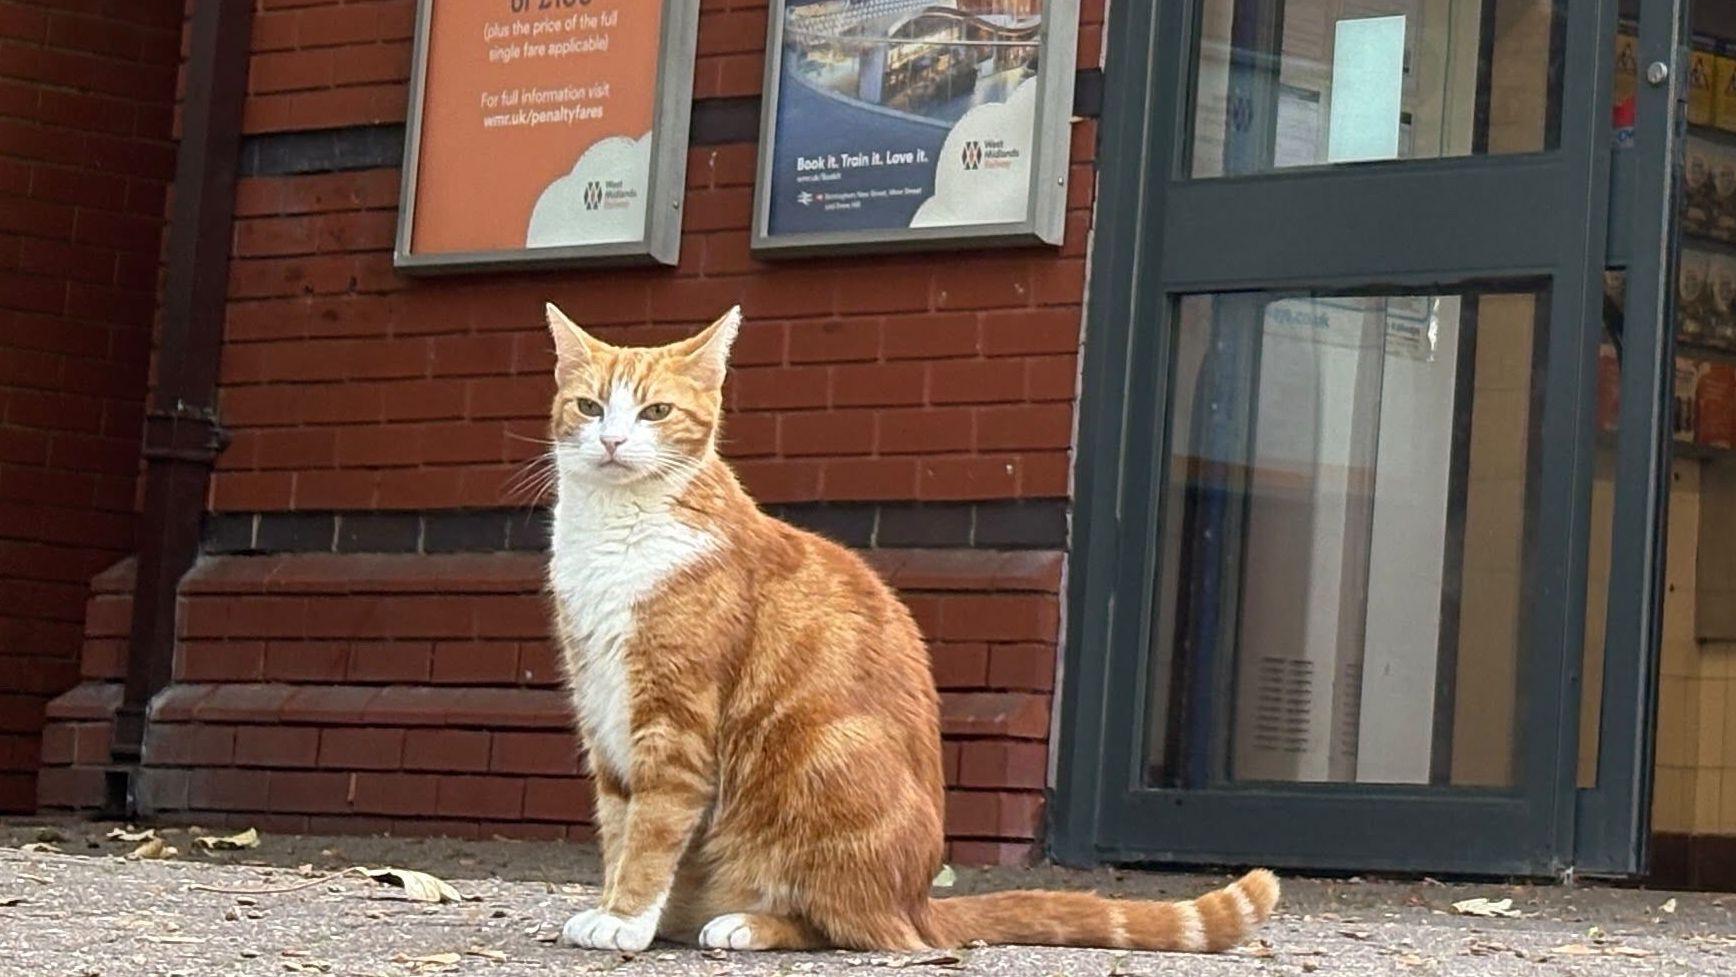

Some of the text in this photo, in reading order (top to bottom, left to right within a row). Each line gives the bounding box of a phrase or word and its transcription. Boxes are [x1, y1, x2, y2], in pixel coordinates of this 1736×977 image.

[484, 10, 618, 42] (plus the price of the full
[489, 34, 609, 63] single fare applicable)
[481, 82, 609, 108] For full information visit
[484, 105, 603, 127] wmr.uk/penaltyfares
[797, 148, 929, 171] Book it. Train it. Love it.
